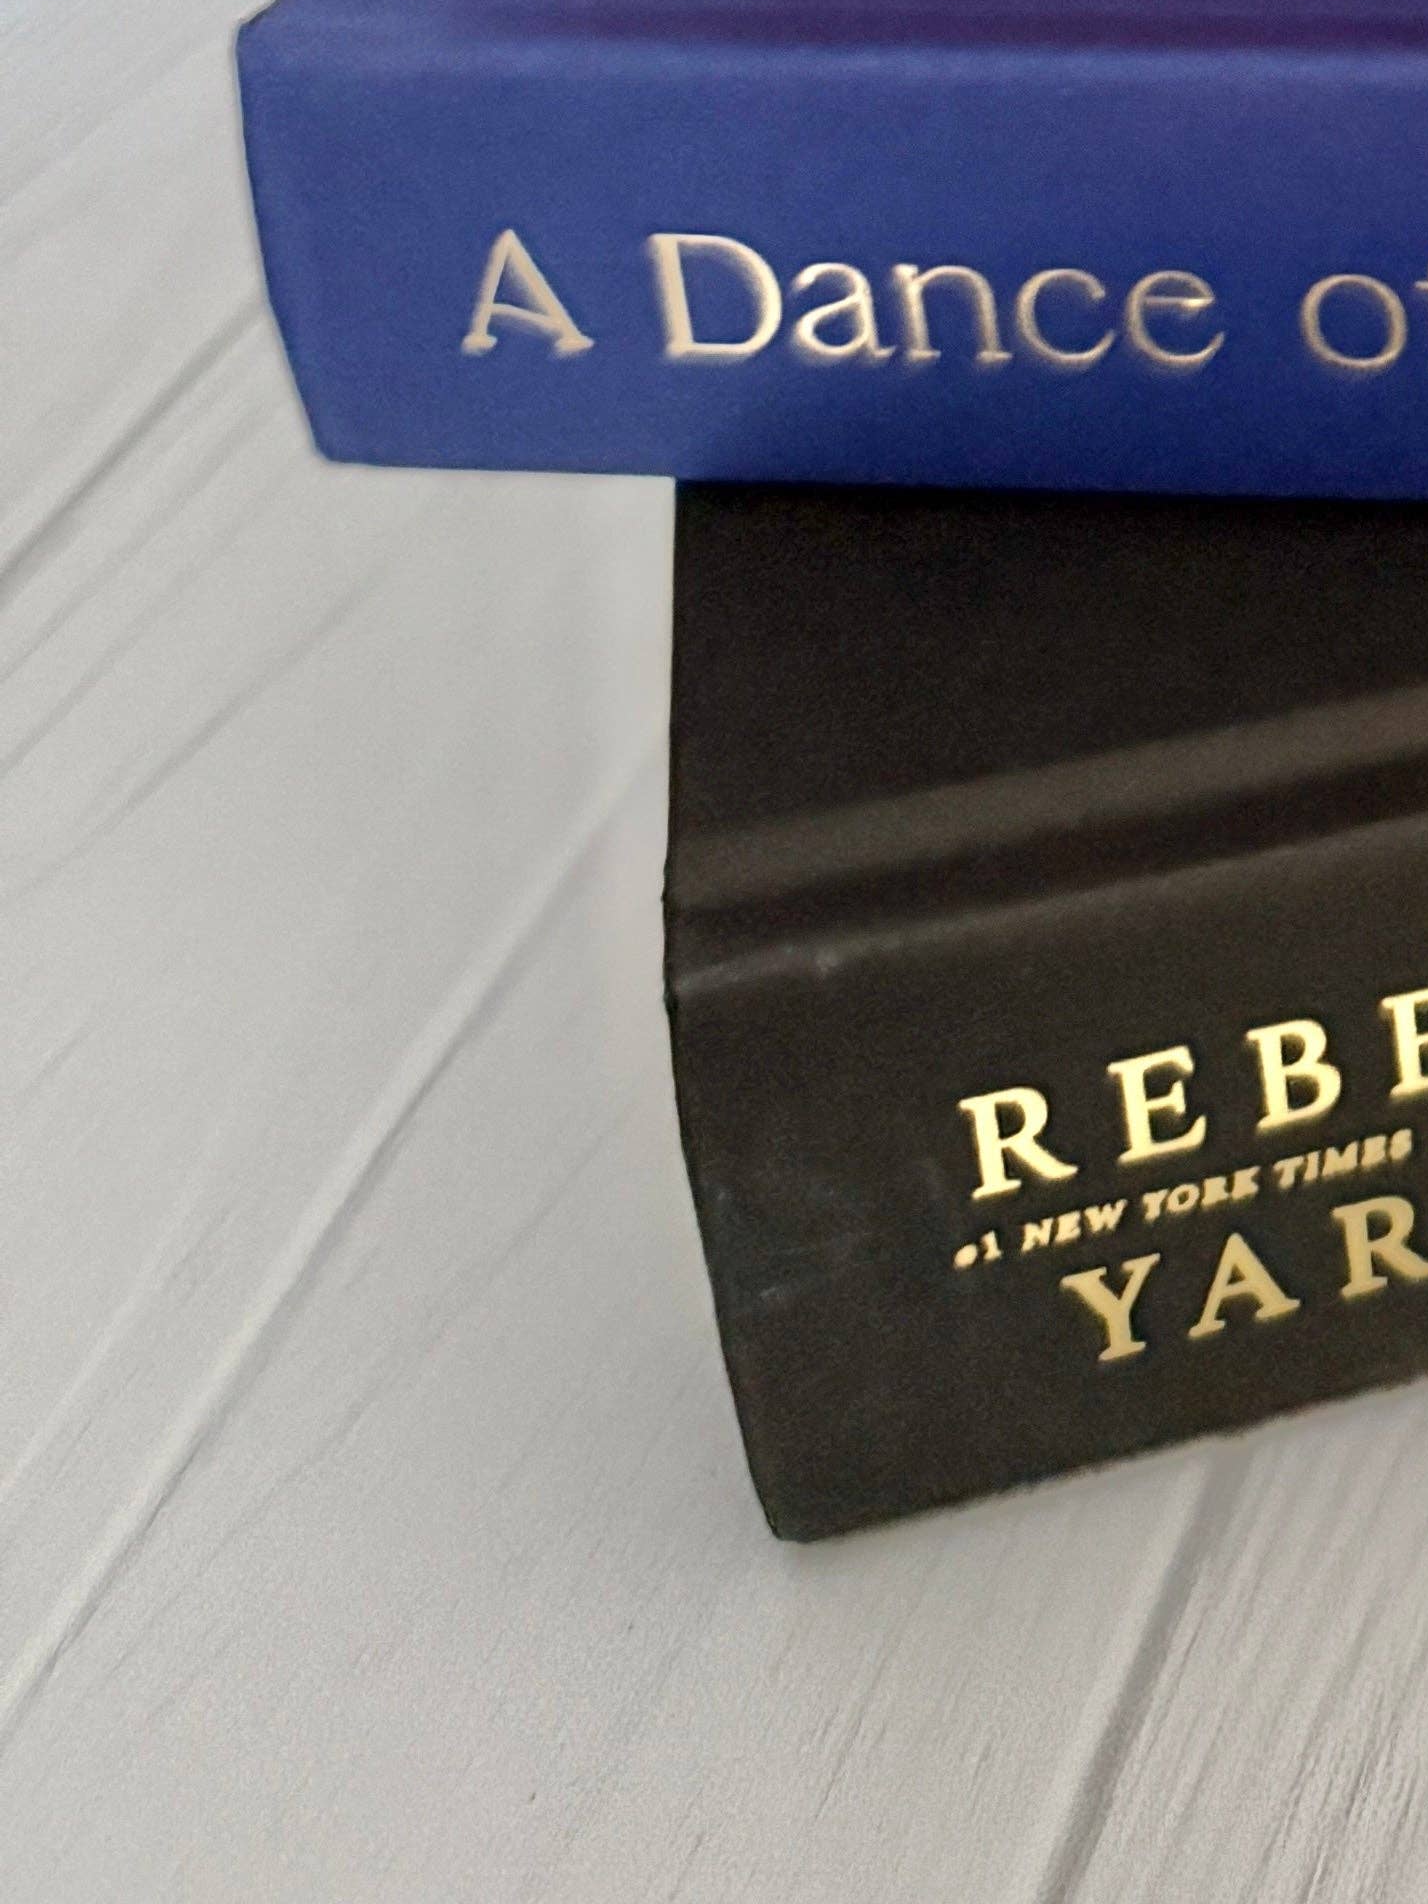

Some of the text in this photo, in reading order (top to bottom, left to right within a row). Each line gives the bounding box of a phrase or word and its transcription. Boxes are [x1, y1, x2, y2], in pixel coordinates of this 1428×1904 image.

[461, 227, 595, 359] A
[647, 233, 1227, 370] Dance
[1021, 1199, 1127, 1255] NEW
[1141, 1165, 1262, 1222] YORK
[1272, 1127, 1413, 1190] TIMES
